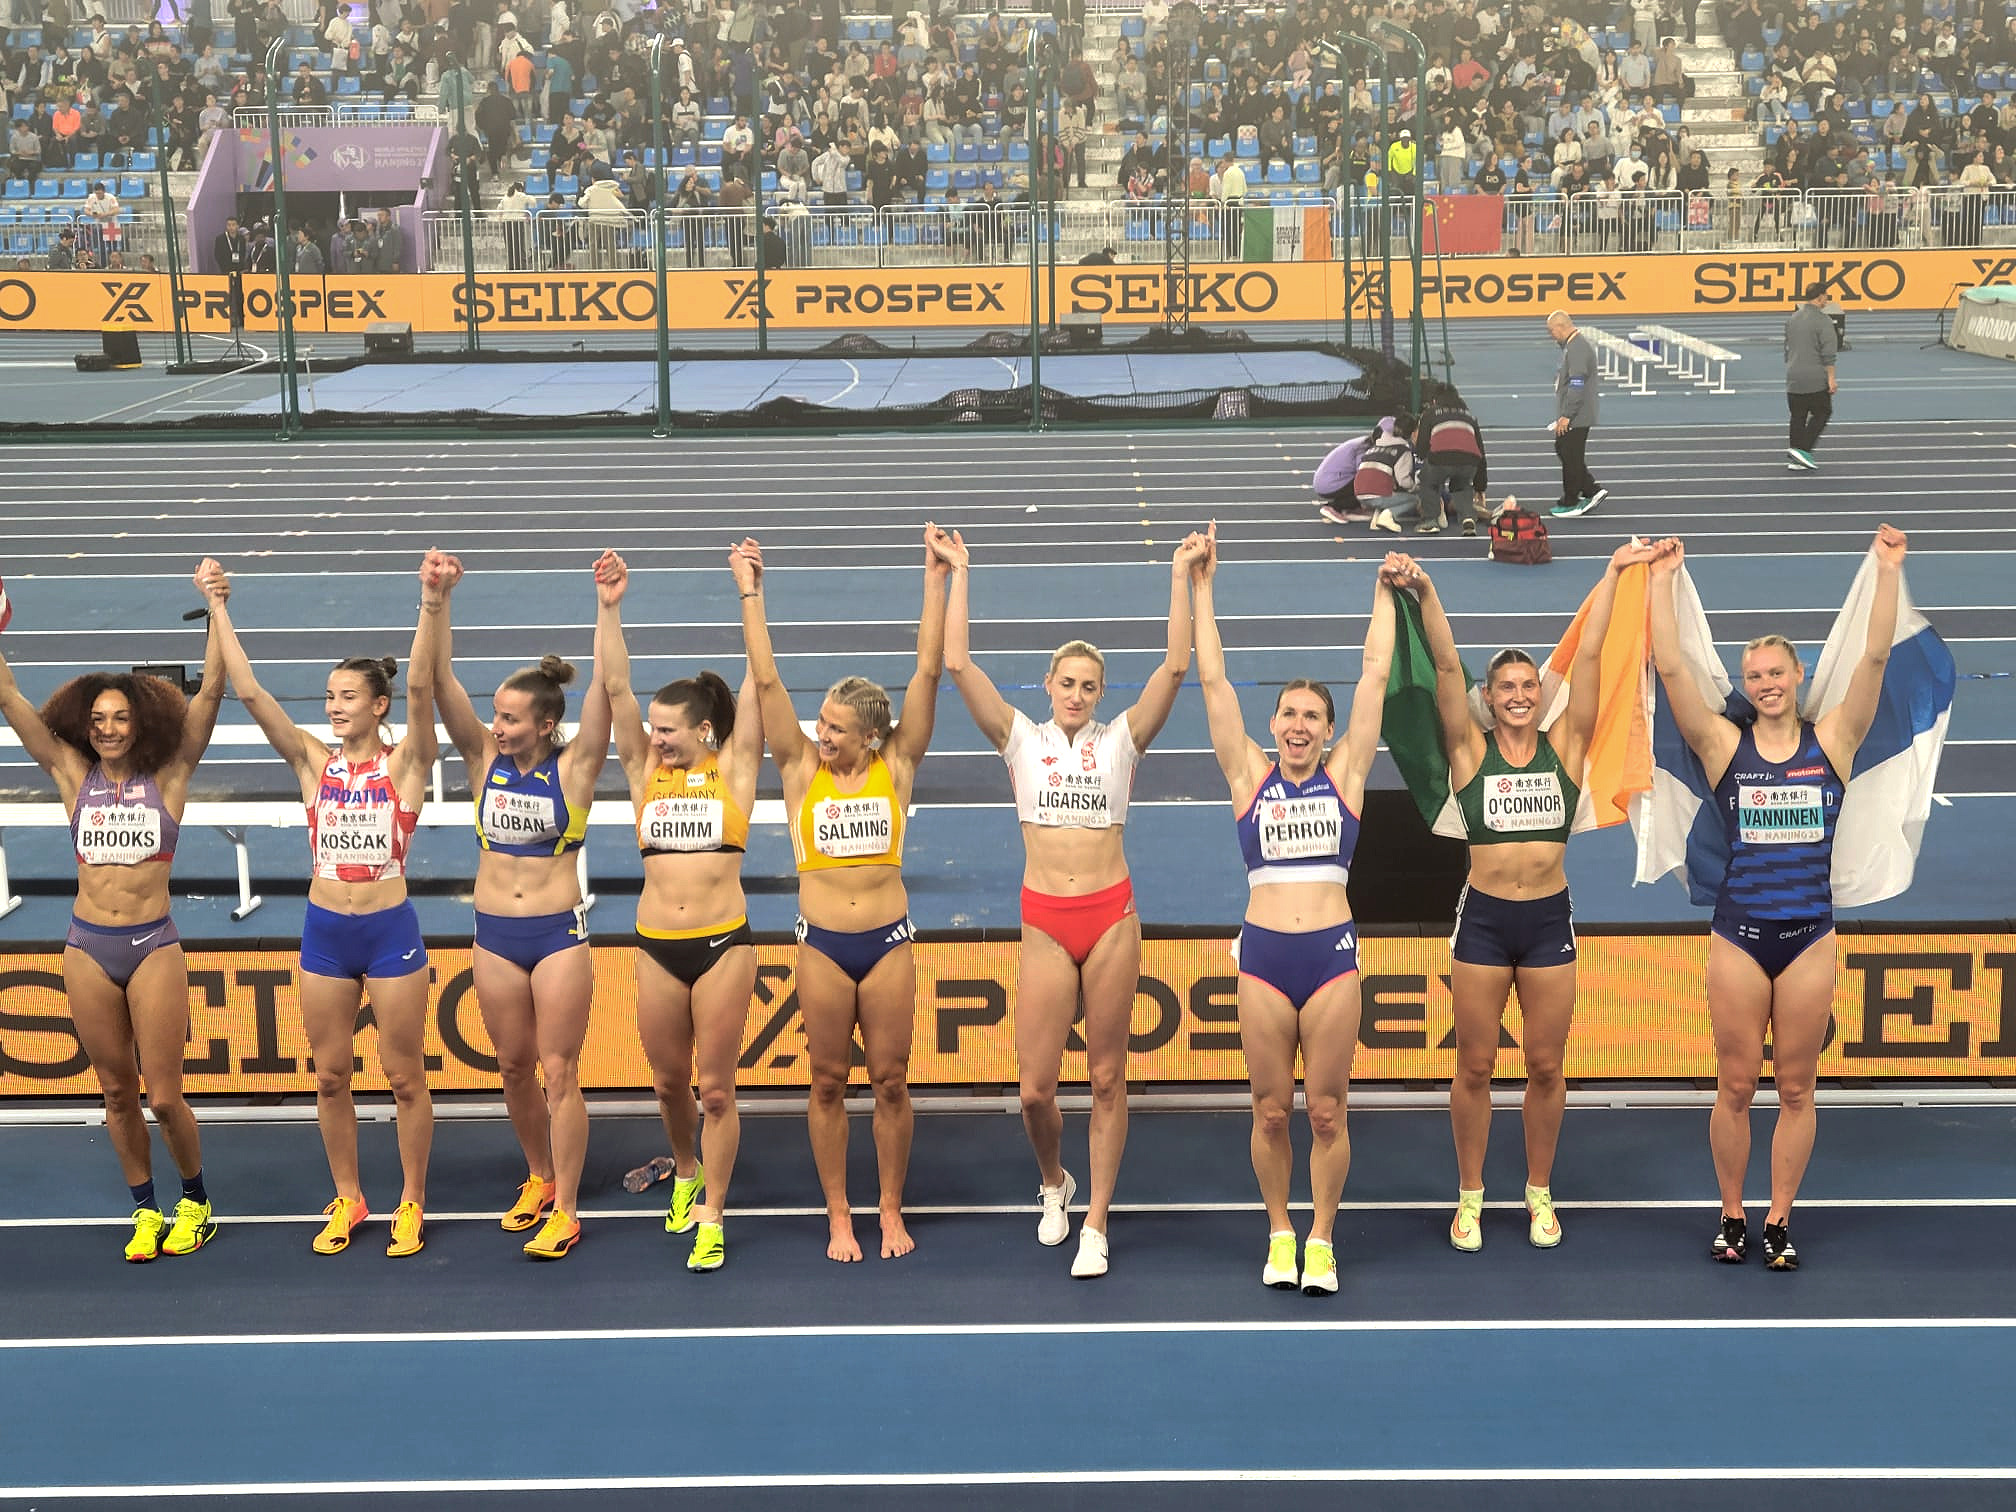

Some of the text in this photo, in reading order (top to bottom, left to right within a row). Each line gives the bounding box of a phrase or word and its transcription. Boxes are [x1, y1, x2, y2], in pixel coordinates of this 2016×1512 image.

[1420, 271, 1627, 304] PROSPEX
[1694, 259, 1906, 304] SEIKO
[452, 279, 658, 323] SEIKO
[796, 282, 1005, 314] PROSPEX
[1071, 271, 1279, 313] SEIKO
[1734, 772, 1765, 780] CRAFT
[319, 784, 389, 804] CROATIA
[1039, 791, 1107, 811] LIGARSKA
[1489, 795, 1561, 815] O'CONNOR
[492, 812, 546, 833] LOBAN
[1743, 808, 1819, 827] VANNINEN
[82, 830, 155, 848] BROOKS
[650, 821, 712, 838] GRIMM
[819, 820, 888, 841] SALMING
[1265, 820, 1337, 842] PERRON
[321, 831, 388, 849] KOŠČAK
